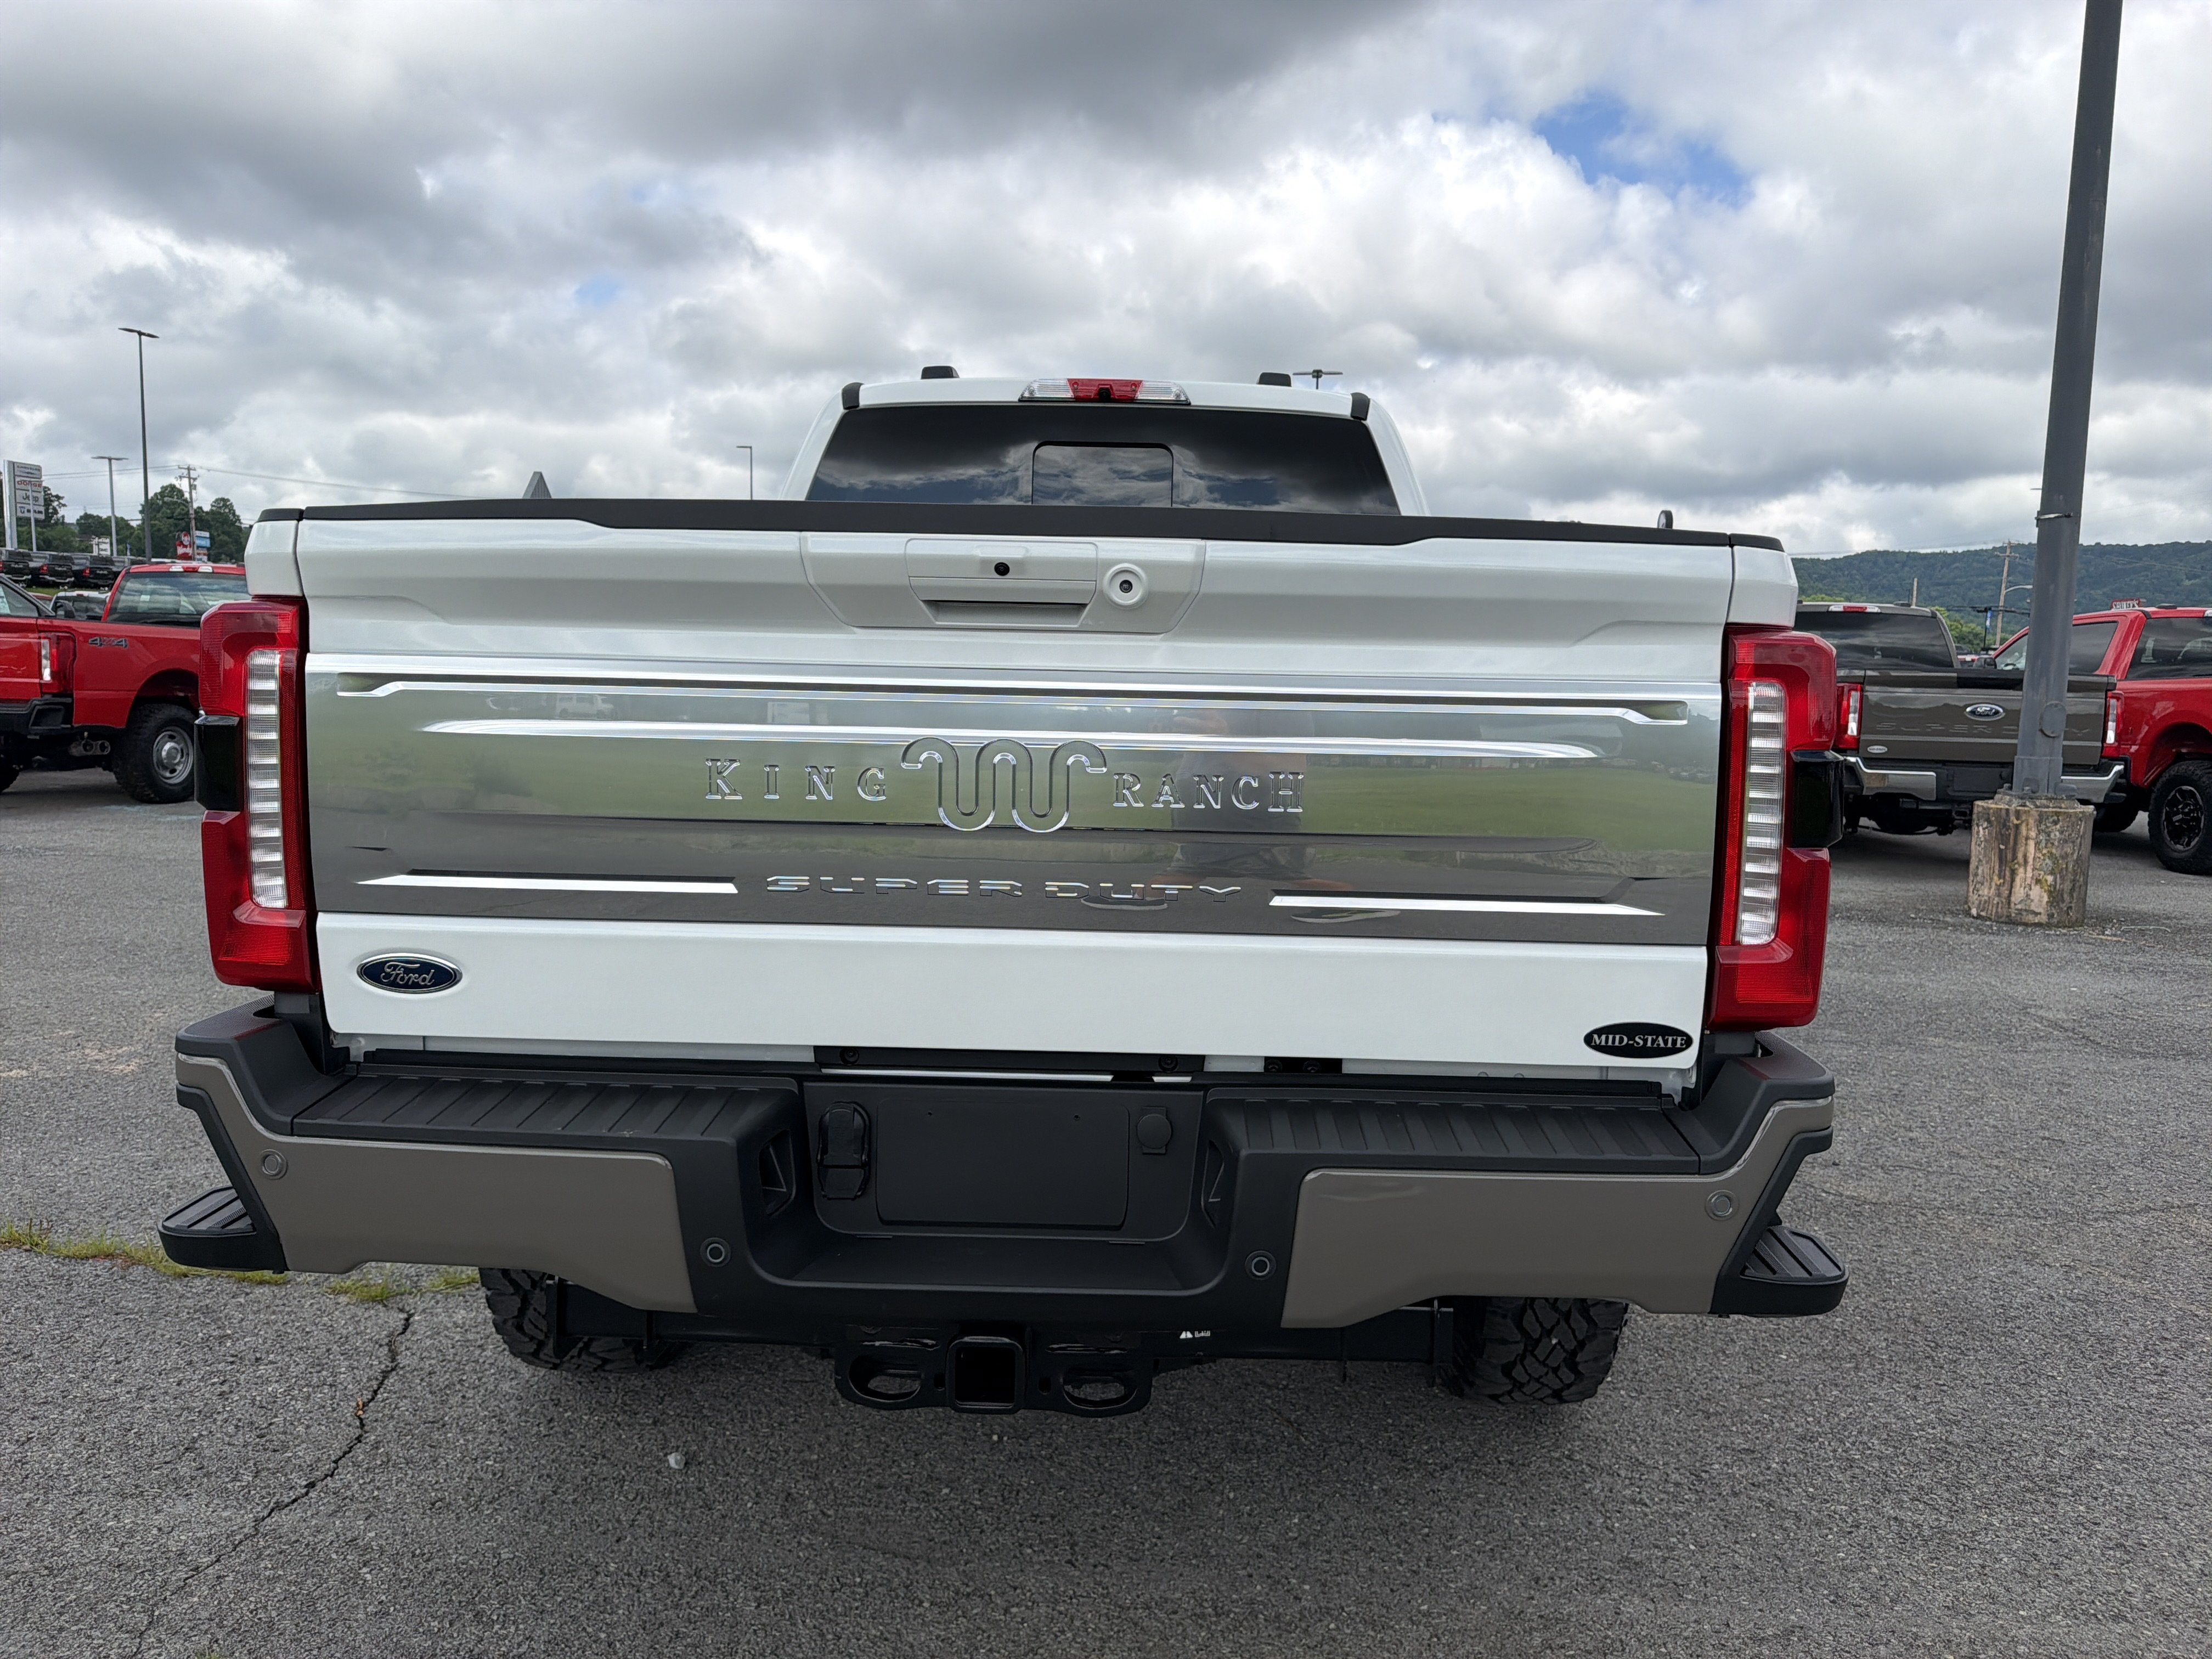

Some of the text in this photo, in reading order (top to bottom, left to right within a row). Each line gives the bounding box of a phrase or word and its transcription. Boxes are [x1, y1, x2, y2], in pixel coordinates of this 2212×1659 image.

[1975, 706, 1996, 716] Ford
[705, 758, 1304, 813] KING RANCH
[766, 875, 1242, 902] SUPER DUTY
[381, 961, 435, 986] Ford
[1591, 1034, 1687, 1048] MID-STATE
